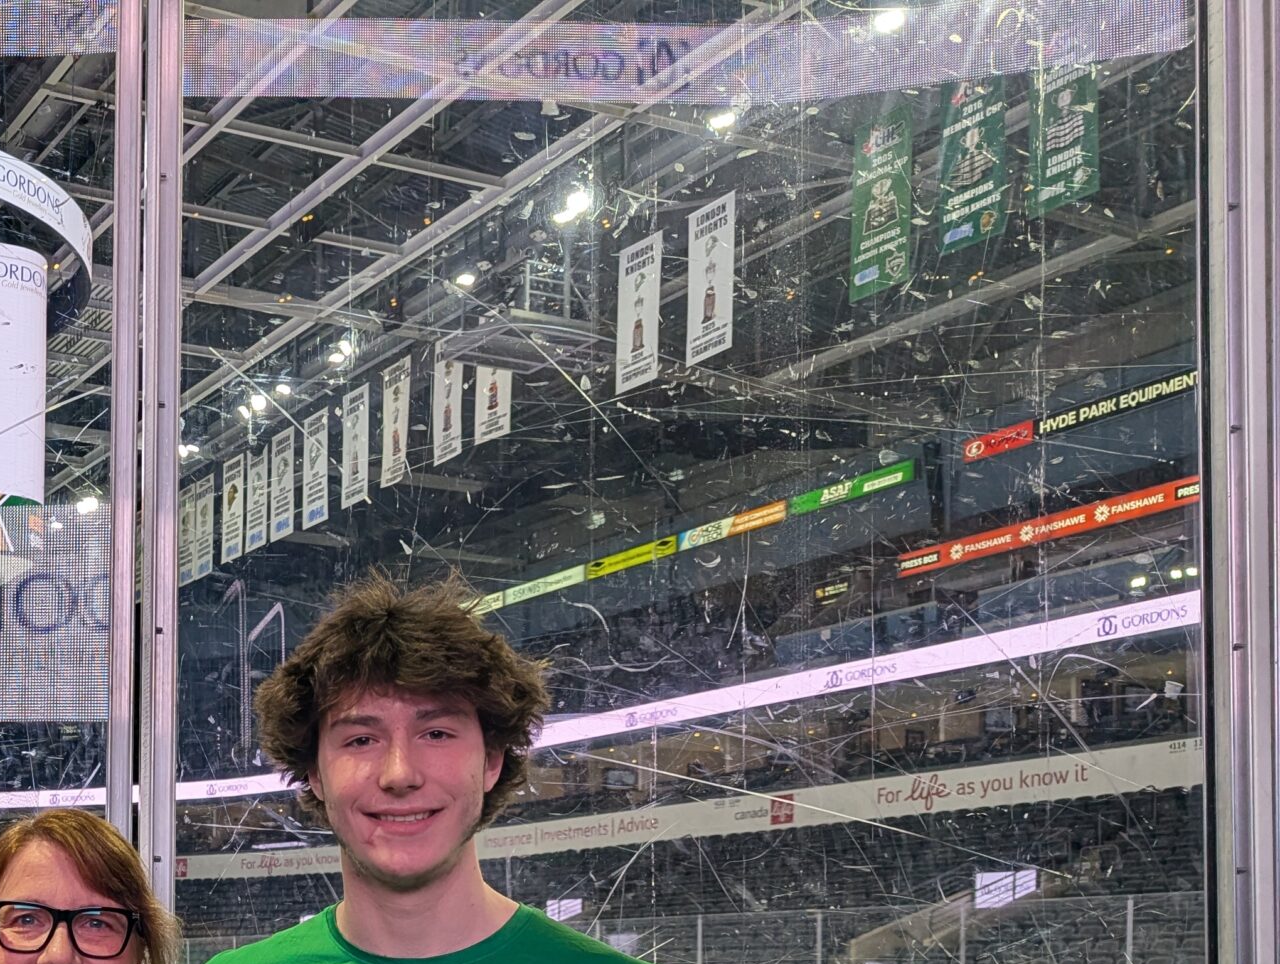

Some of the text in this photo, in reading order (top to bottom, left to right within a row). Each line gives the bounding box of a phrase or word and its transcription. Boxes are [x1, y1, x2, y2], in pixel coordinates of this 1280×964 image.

[696, 202, 727, 228] LONDON
[694, 214, 728, 242] KNIGHTS
[625, 255, 655, 278] KNIGHTS
[1039, 411, 1077, 435] HYDE
[1079, 398, 1117, 422] PARK
[1110, 493, 1165, 515] FANSHAWE
[1034, 514, 1087, 535] FANSHAWE
[964, 534, 1012, 554] FANSHAWE
[900, 553, 939, 570] PRESS BOX
[1120, 604, 1189, 630] GORDONS
[845, 662, 898, 683] GORDONS
[877, 763, 1088, 811] For life as you know it
[734, 808, 769, 821] canada
[484, 815, 660, 849] Insurance Investments Advice
[241, 859, 256, 870] For
[258, 853, 282, 875] life
[283, 857, 294, 867] as
[296, 855, 313, 870] you
